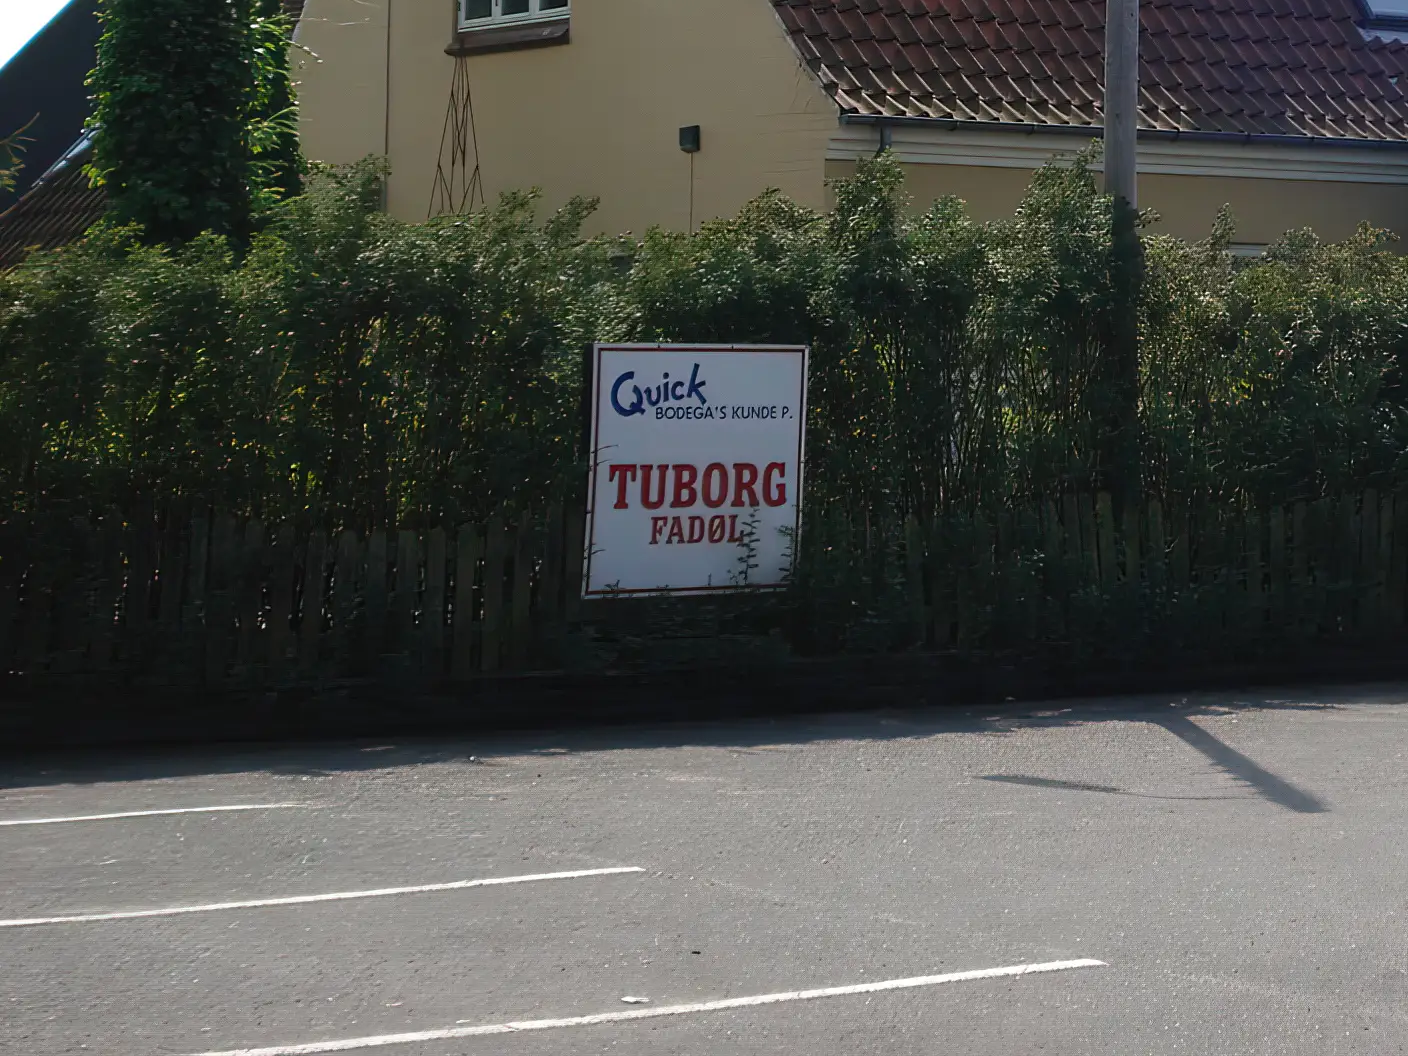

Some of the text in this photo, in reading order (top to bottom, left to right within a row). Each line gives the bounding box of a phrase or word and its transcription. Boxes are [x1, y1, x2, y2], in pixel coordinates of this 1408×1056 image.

[610, 363, 708, 417] Quick
[655, 405, 794, 420] BODEGA'S KUNDE P.
[609, 461, 788, 509] TUBORG
[649, 514, 743, 544] FADØL
